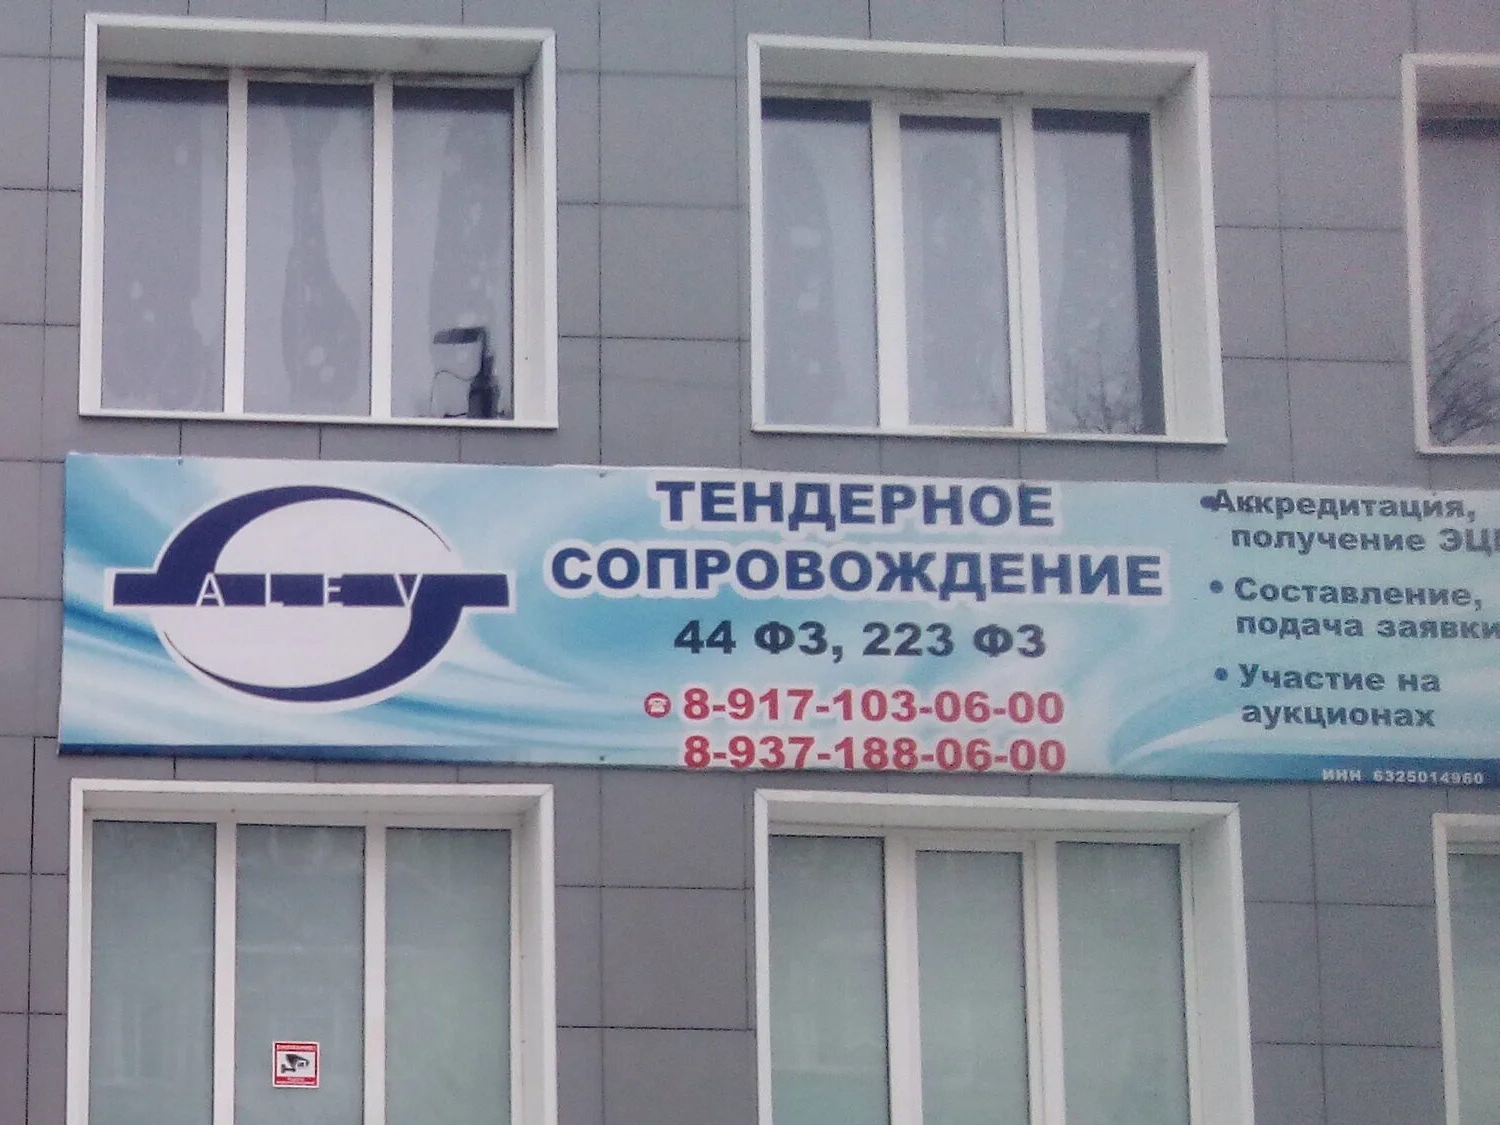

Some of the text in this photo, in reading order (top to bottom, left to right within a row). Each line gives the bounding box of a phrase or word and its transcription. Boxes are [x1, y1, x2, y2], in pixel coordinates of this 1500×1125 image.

[656, 480, 1055, 531] ТЕНДЕРНОЕ
[1232, 528, 1426, 555] получение
[550, 546, 1163, 601] СОПРОВОЖДЕНИЕ
[1234, 577, 1482, 611] Составление,
[674, 619, 737, 654] 44
[863, 621, 954, 656] 223
[1236, 615, 1364, 640] подача
[1238, 663, 1441, 692] Участие на
[682, 687, 1065, 725] 8-917-103-06-00
[1241, 704, 1436, 730] аукционах
[683, 734, 1067, 772] 8-937-188-06-00
